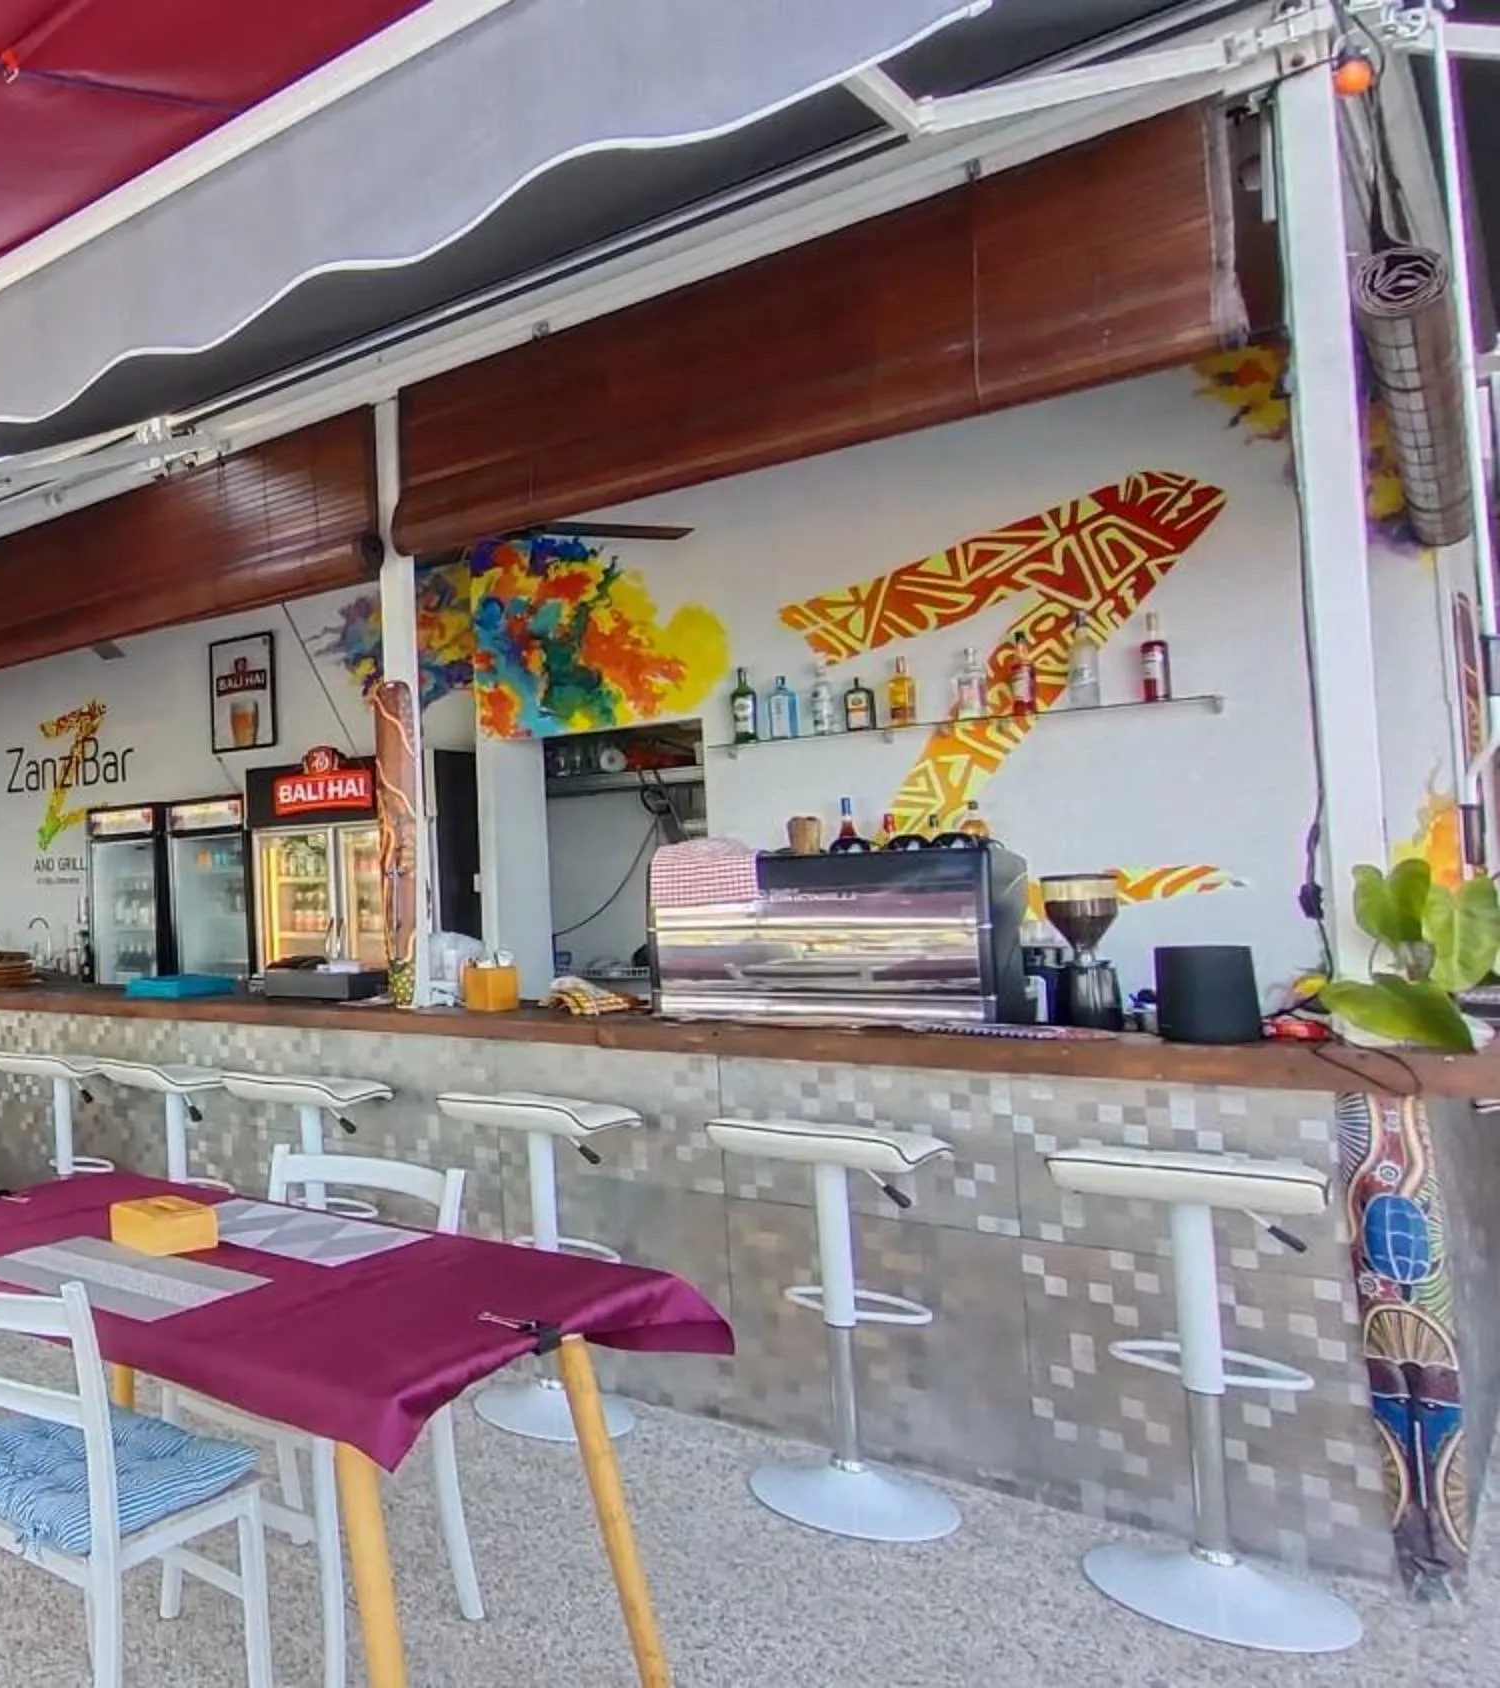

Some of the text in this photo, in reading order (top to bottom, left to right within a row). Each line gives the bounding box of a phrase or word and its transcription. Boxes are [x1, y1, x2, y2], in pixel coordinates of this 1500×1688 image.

[218, 671, 265, 691] BALI HAI
[6, 737, 134, 793] ZanziBar
[278, 777, 365, 804] BALI HAI
[33, 857, 55, 873] AND
